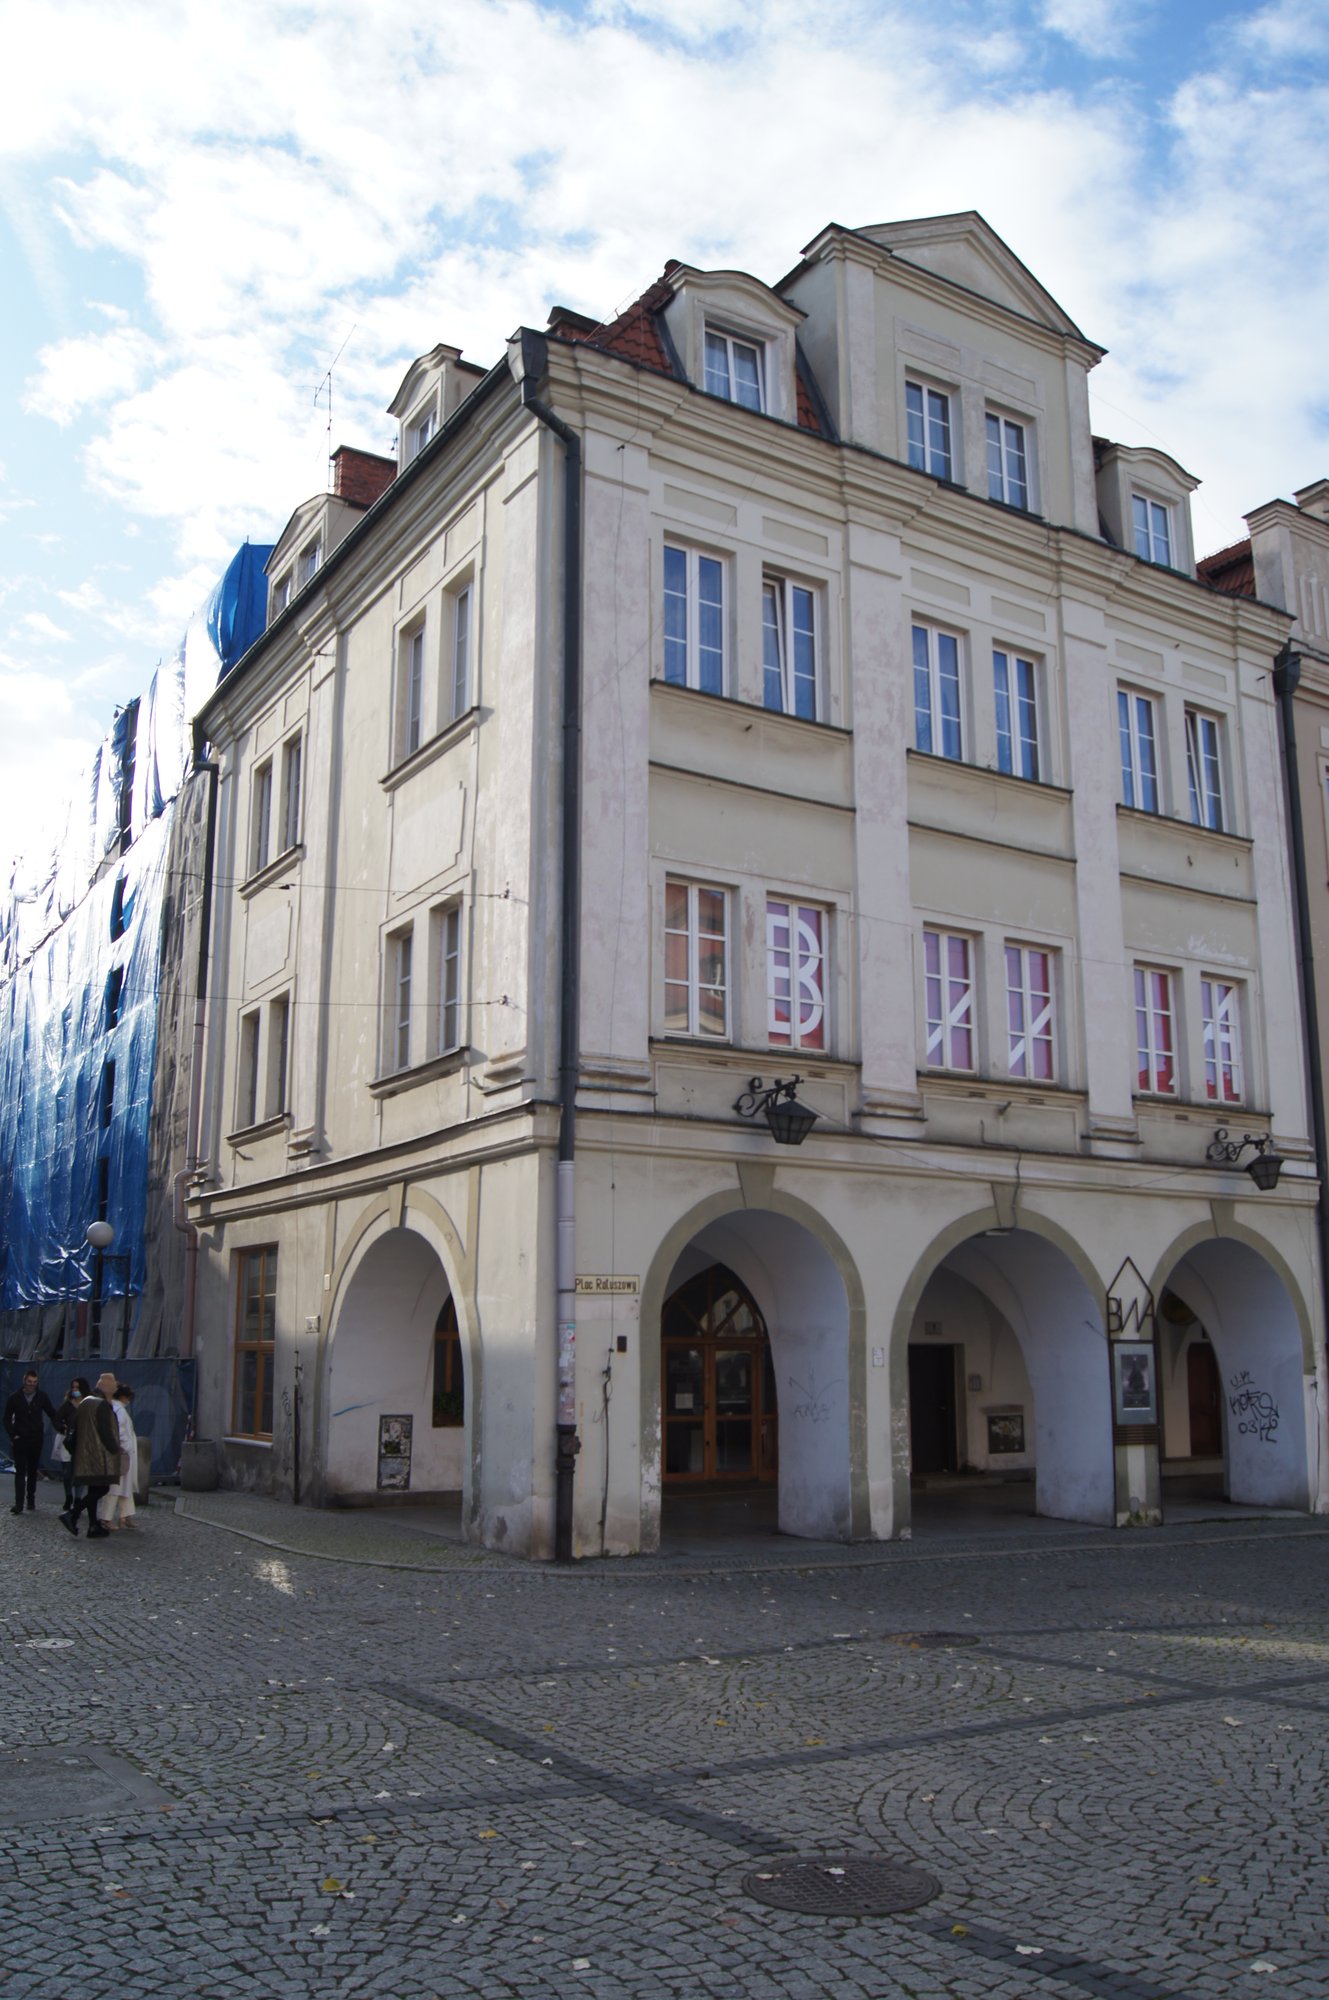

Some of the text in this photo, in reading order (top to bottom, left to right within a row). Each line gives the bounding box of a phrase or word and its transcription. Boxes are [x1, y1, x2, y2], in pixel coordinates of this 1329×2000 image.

[575, 1278, 637, 1292] Plac Ratuszowy
[1107, 1296, 1154, 1333] BWA
